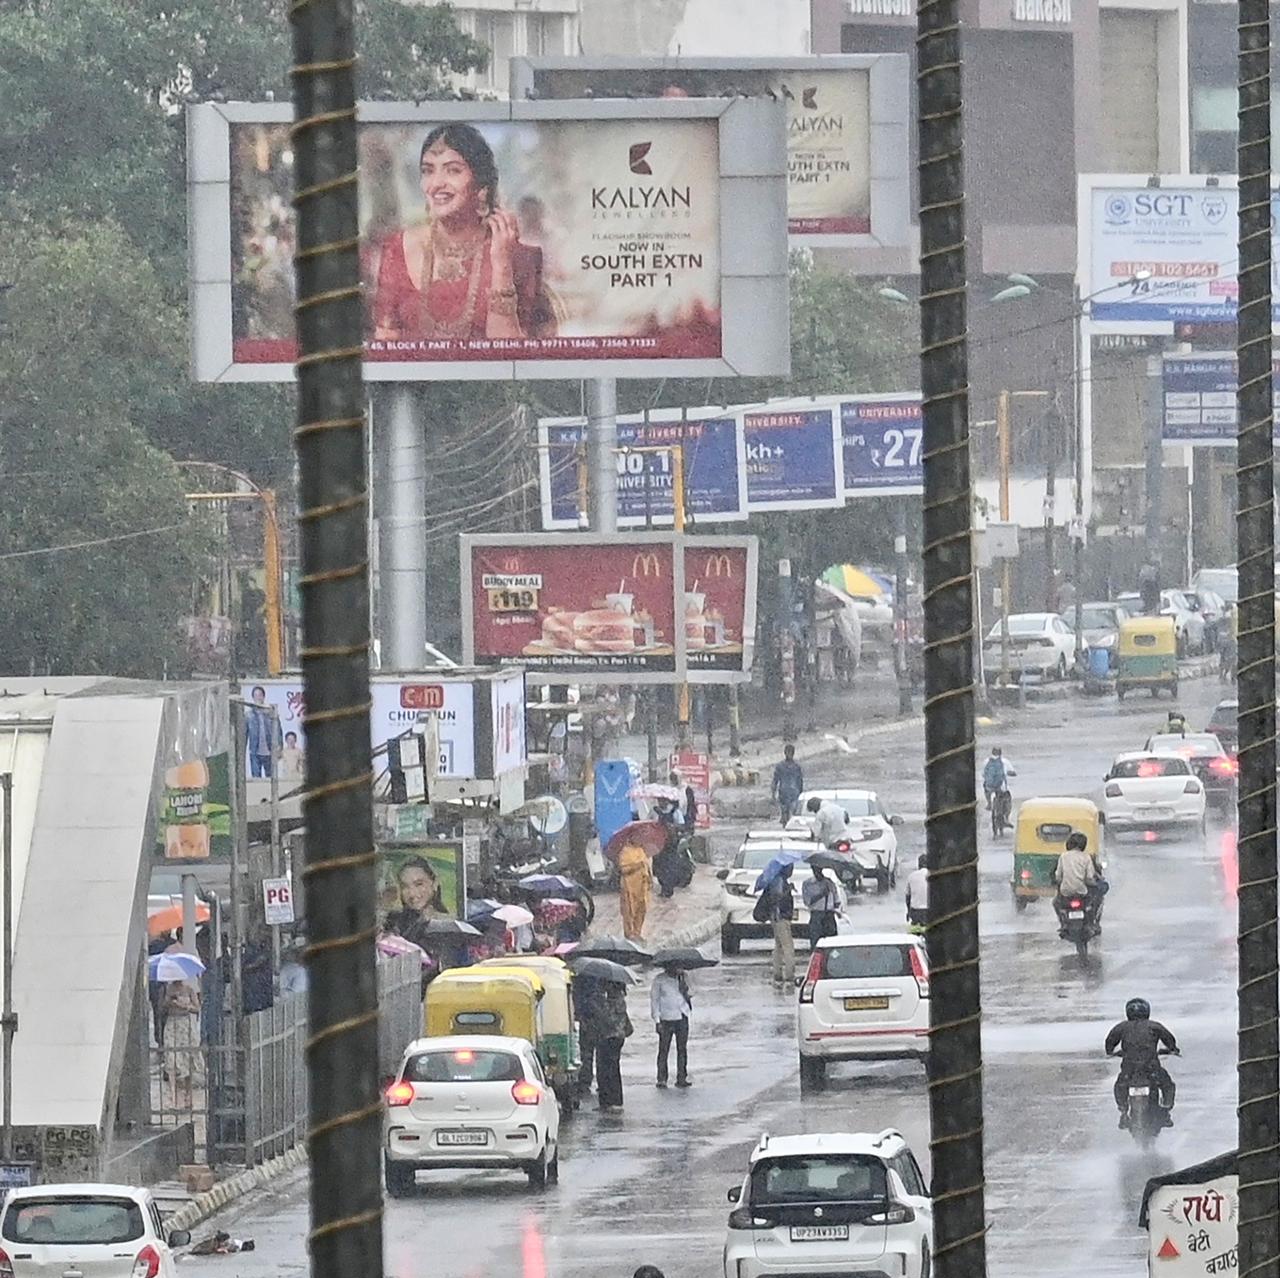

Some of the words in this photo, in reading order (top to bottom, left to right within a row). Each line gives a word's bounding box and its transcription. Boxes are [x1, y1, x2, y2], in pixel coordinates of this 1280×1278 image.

[789, 116, 843, 131] ALYAN
[592, 186, 690, 209] KALYAN
[1135, 194, 1192, 216] SGT
[619, 242, 649, 252] NOW
[652, 242, 665, 252] IN
[581, 255, 645, 270] SOUTH
[652, 254, 703, 269] EXTN
[611, 272, 657, 287] PART
[665, 272, 672, 287] 1
[469, 340, 490, 349] NEW
[388, 710, 457, 722] CHUUN
[266, 888, 289, 904] PG
[1183, 1189, 1224, 1226] राधे
